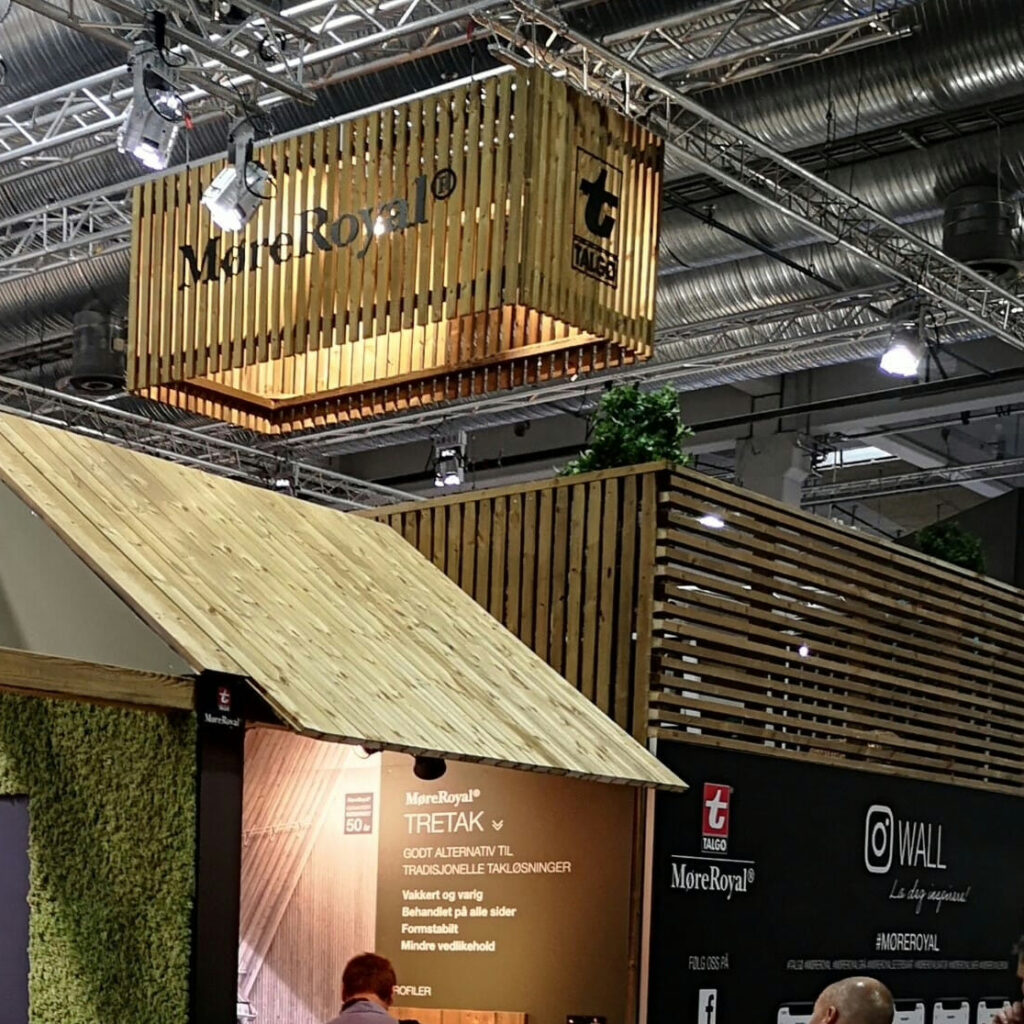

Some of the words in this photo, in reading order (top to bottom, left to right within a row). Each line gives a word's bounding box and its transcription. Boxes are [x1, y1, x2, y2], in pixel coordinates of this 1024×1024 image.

[574, 242, 617, 283] TALGO
[403, 811, 485, 834] TRETAK
[403, 847, 433, 859] GODT
[434, 846, 496, 858] ALTERNATIV
[497, 845, 514, 857] TIL
[702, 837, 727, 852] TALGO
[898, 820, 947, 870] WALL
[403, 863, 485, 876] TRADISJONELLE
[487, 861, 572, 874] TAKLØSNINGER
[402, 889, 441, 901] Vakkert
[442, 892, 456, 902] og
[457, 889, 484, 902] varig
[401, 906, 453, 918] Behandlet
[454, 905, 468, 919] på
[469, 906, 488, 918] alle
[489, 906, 518, 918] sider
[401, 923, 459, 934] Formstabilt
[401, 940, 436, 951] Mindre
[437, 940, 496, 952] vedlikehold
[876, 932, 940, 952] #MØREROYAL
[688, 956, 706, 971] FØLG
[706, 955, 720, 970] OSS
[721, 953, 729, 970] PÅ
[392, 985, 432, 997] ROFILER
